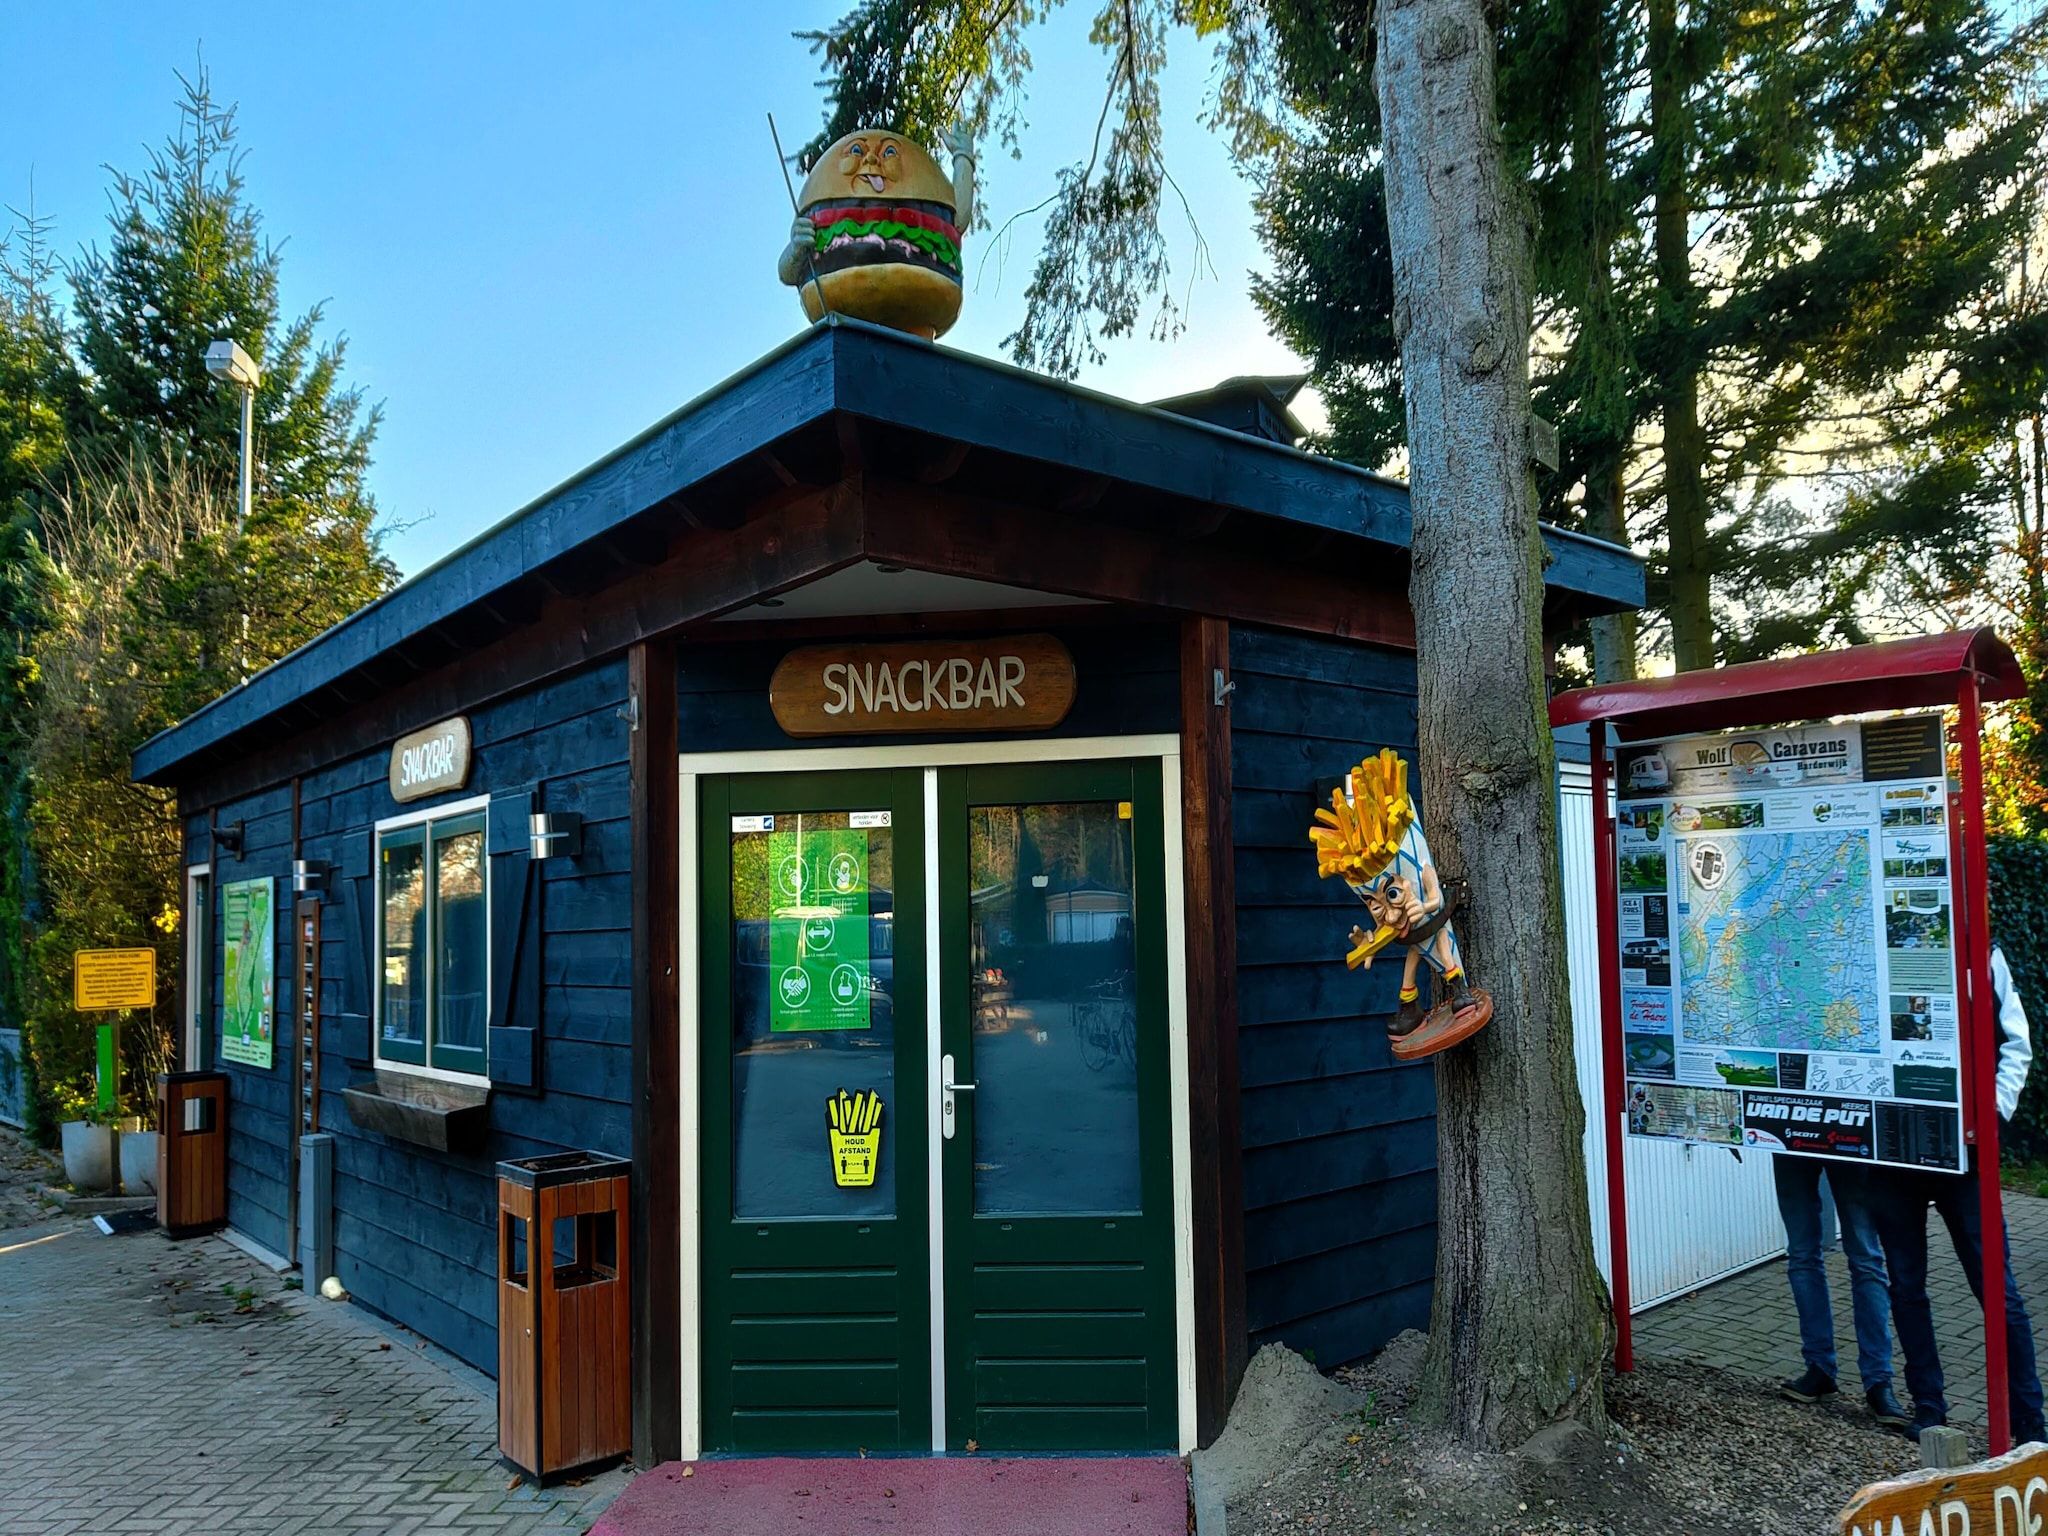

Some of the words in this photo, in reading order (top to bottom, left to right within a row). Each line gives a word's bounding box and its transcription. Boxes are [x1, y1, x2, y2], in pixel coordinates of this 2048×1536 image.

[822, 655, 1026, 715] SNACKBAR
[401, 734, 454, 787] SNACKBAR
[1696, 747, 1726, 764] Wolf
[1774, 739, 1847, 758] Caravans
[1797, 758, 1848, 770] Harderwijk
[1790, 1106, 1824, 1123] DE
[1823, 1108, 1871, 1127] PUT
[1791, 1131, 1821, 1139] SCOTT
